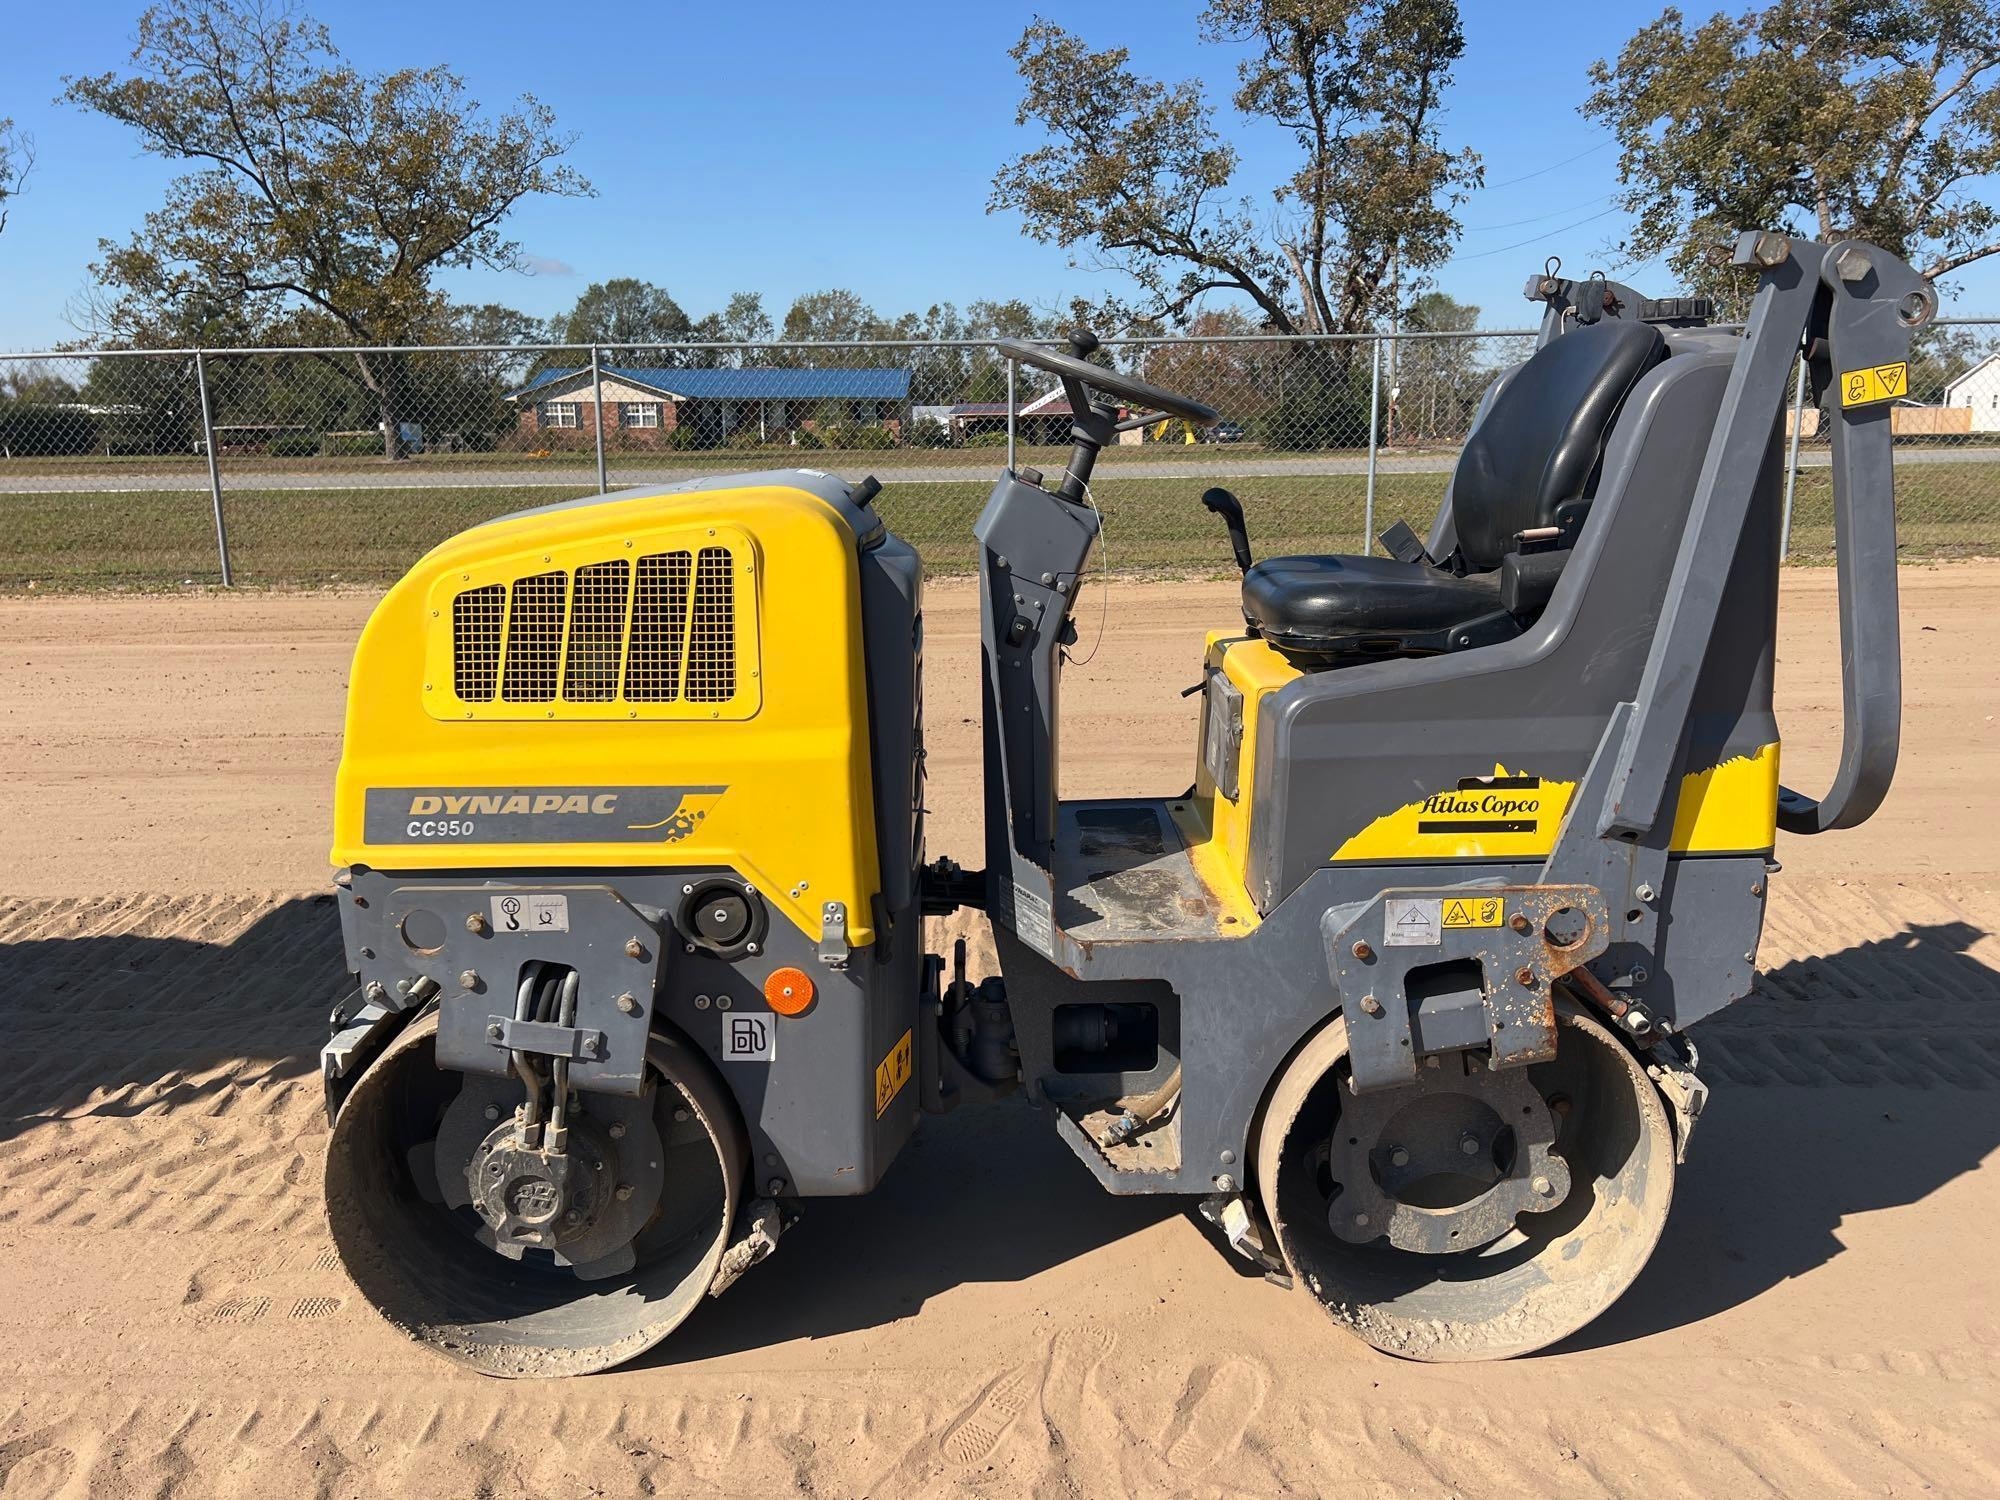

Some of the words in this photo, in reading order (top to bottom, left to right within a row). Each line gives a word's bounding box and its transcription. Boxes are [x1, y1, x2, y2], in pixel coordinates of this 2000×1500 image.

[409, 794, 618, 815] DYNAPAC
[1418, 795, 1479, 814] Atlas
[1481, 795, 1539, 816] Copco
[406, 820, 475, 837] CC950
[737, 1036, 748, 1049] D
